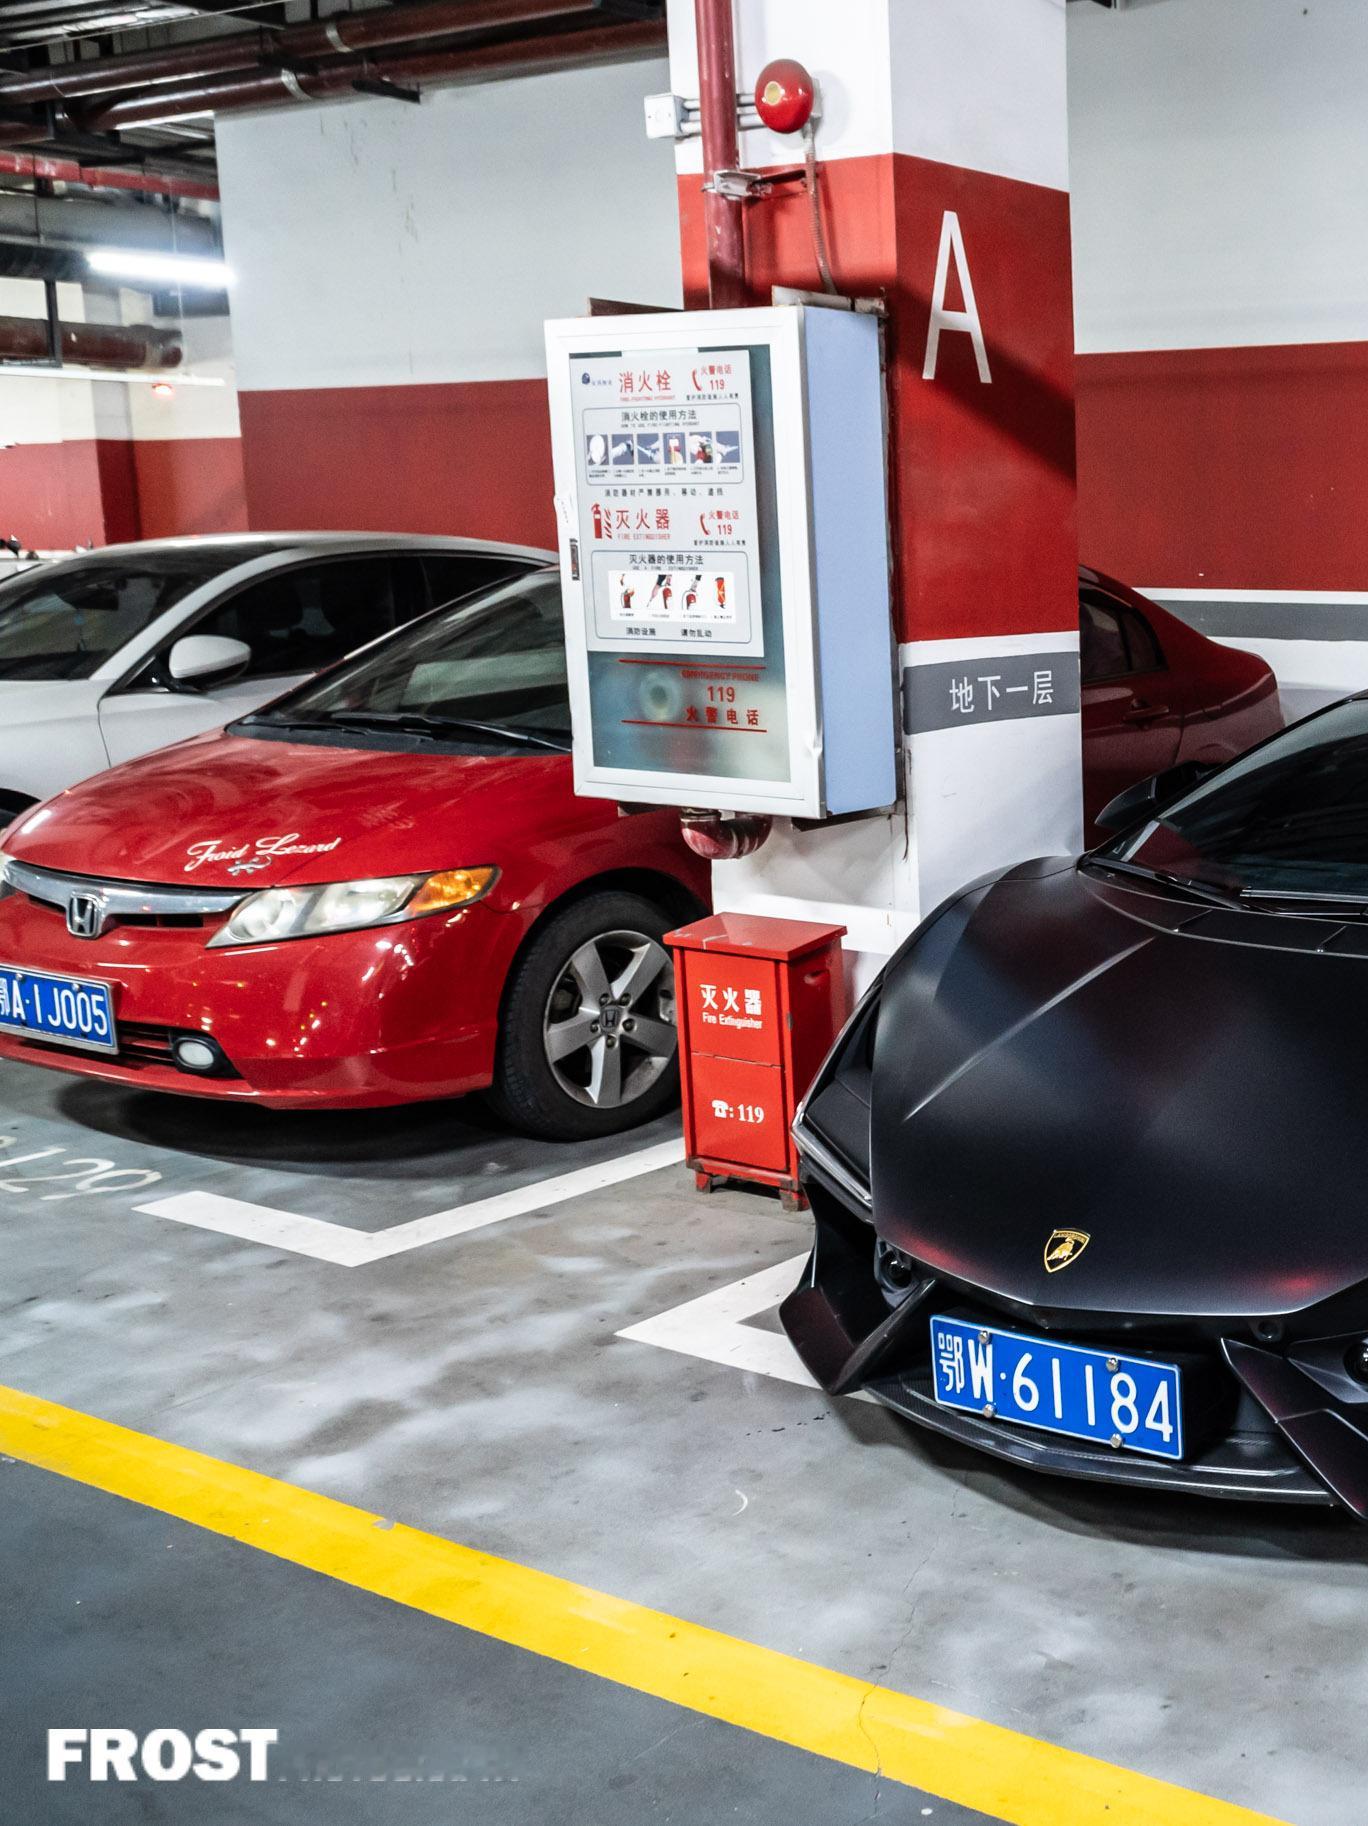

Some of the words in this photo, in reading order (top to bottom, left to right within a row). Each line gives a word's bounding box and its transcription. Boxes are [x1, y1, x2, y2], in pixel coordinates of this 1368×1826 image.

[922, 210, 993, 384] A
[700, 364, 732, 376] 火警电话
[619, 369, 672, 393] 消火栓
[710, 379, 725, 391] 119
[621, 410, 697, 422] 消火栓的使用方法
[615, 508, 670, 530] 灭火器
[708, 510, 740, 521] 火警电话
[717, 524, 733, 536] 119
[629, 554, 705, 566] 灭火器的使用方法
[707, 686, 736, 703] 119
[949, 670, 1054, 714] 地下一层
[685, 705, 760, 726] 火警电话
[700, 983, 762, 1016] 灭火器
[702, 1012, 717, 1025] Fire
[719, 1014, 763, 1030] Extinguisher
